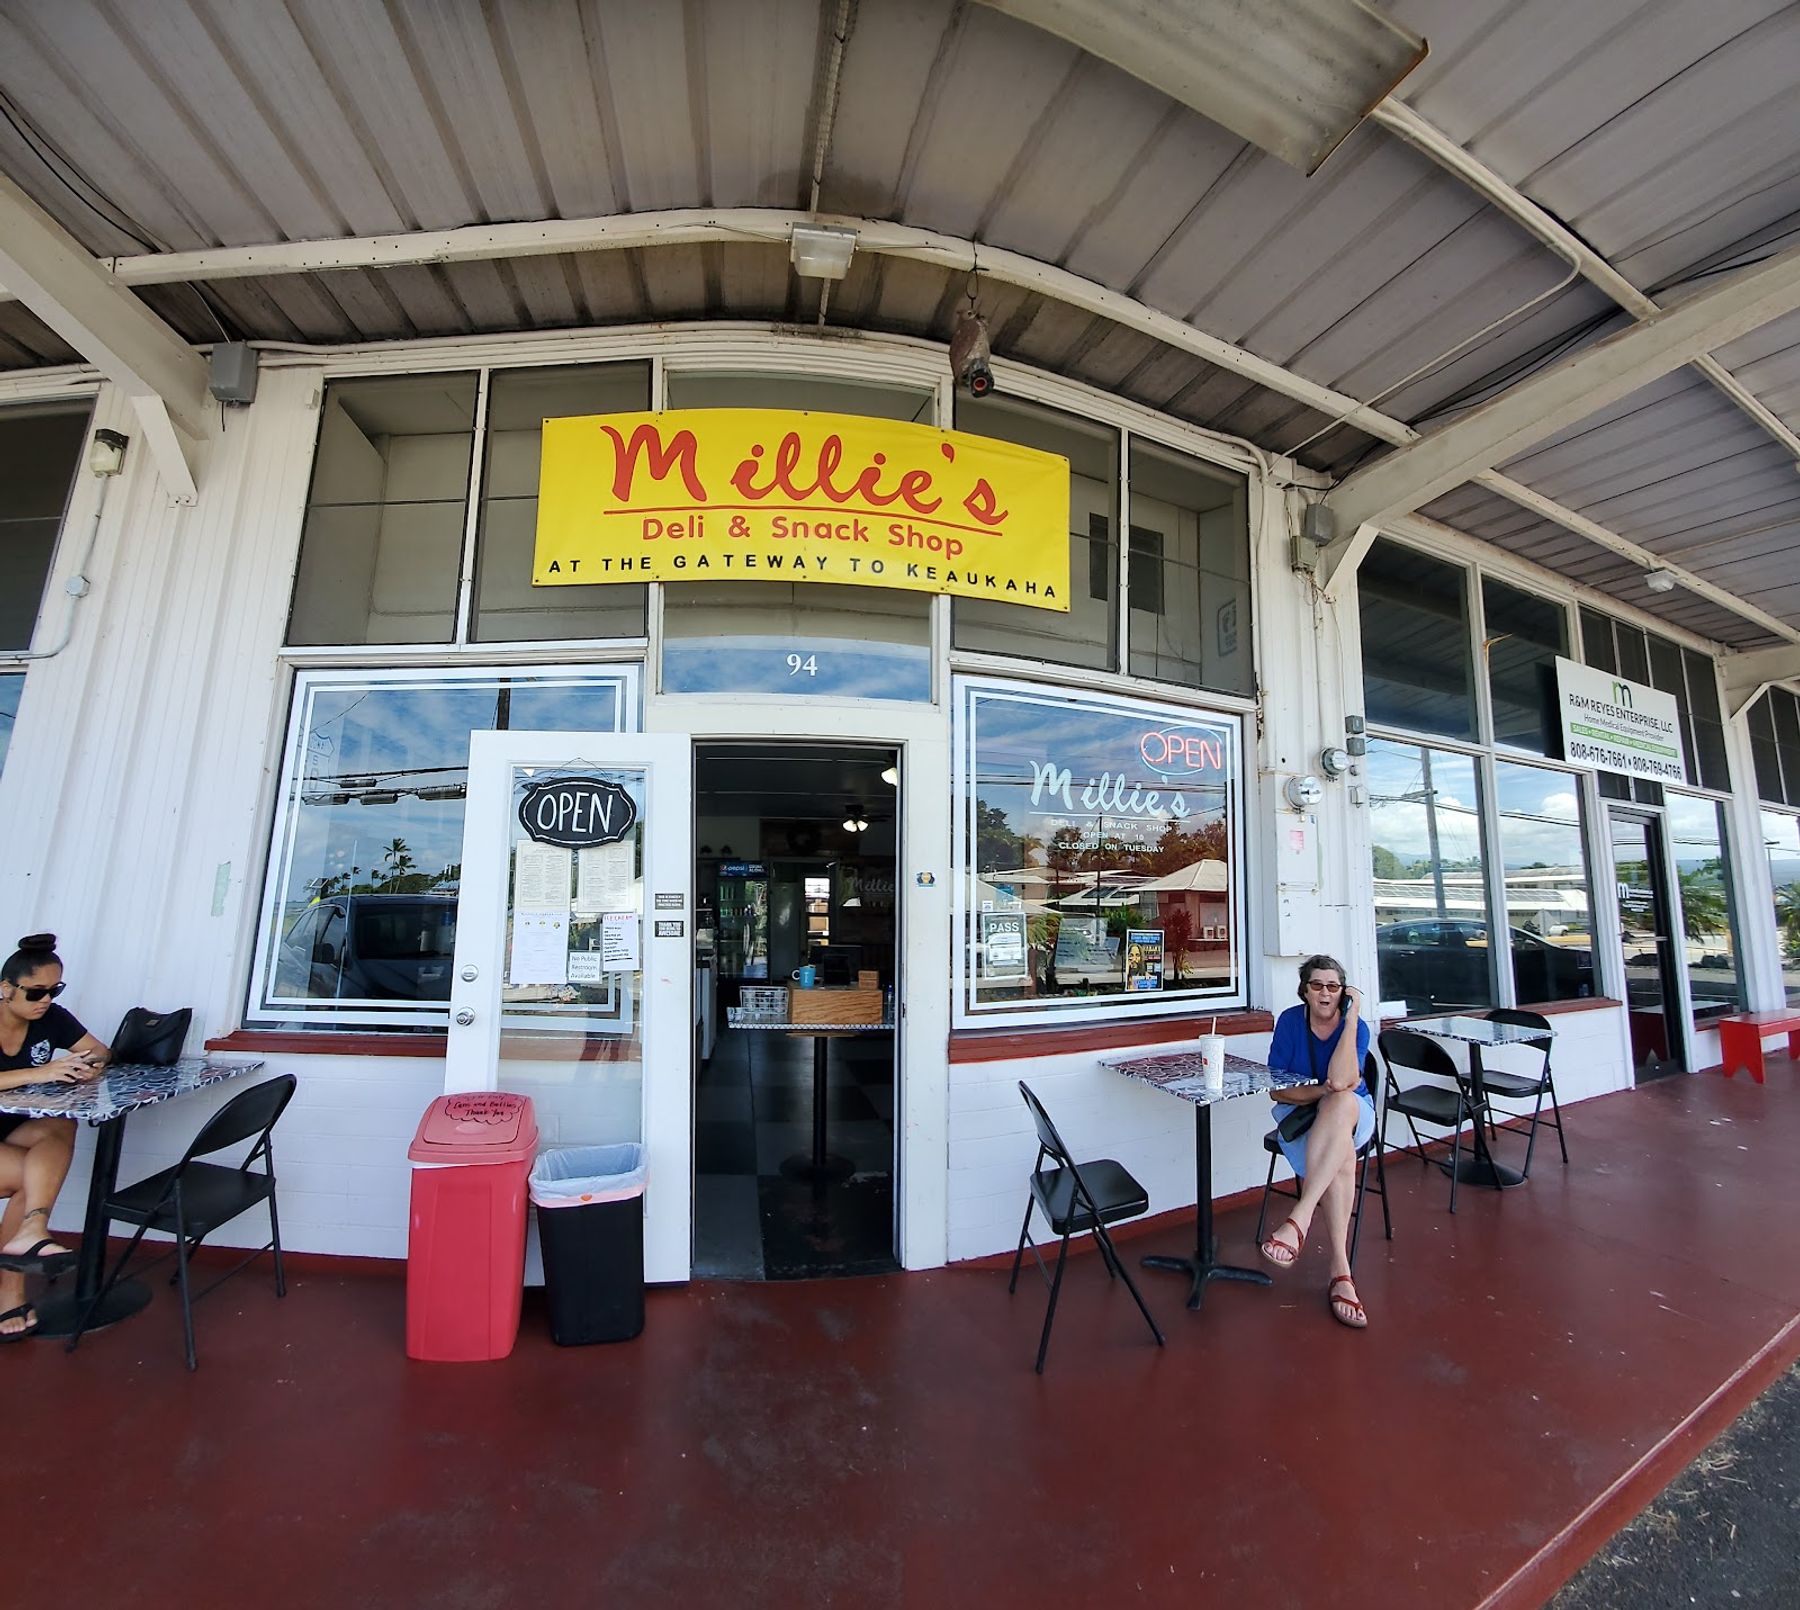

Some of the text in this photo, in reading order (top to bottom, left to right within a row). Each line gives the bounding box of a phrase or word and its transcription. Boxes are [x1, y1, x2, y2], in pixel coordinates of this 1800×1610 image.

[600, 424, 1009, 526] Millie's
[642, 515, 964, 560] Deli & Snack Shop
[549, 554, 1057, 599] AT THE GATEWAY TO KEAUKAHA
[786, 653, 818, 678] 94
[1569, 693, 1673, 733] R&M REYES ENTERPRISE, LLC
[1584, 713, 1664, 741] Home Medical Equipment Provider
[1141, 732, 1222, 770] OPEN
[1570, 741, 1627, 770] 808-676-7661
[1030, 760, 1191, 818] Millie's
[536, 791, 613, 834] OPEN
[1051, 819, 1076, 827] DELI
[1103, 821, 1138, 830] SNACK
[1146, 824, 1173, 833] SHOP
[1058, 841, 1165, 853] CLOSED ON TUESDAY
[1083, 831, 1109, 839] OPEN
[1115, 832, 1126, 840] AT
[989, 922, 1020, 933] PASS
[571, 963, 598, 971] Restroom
